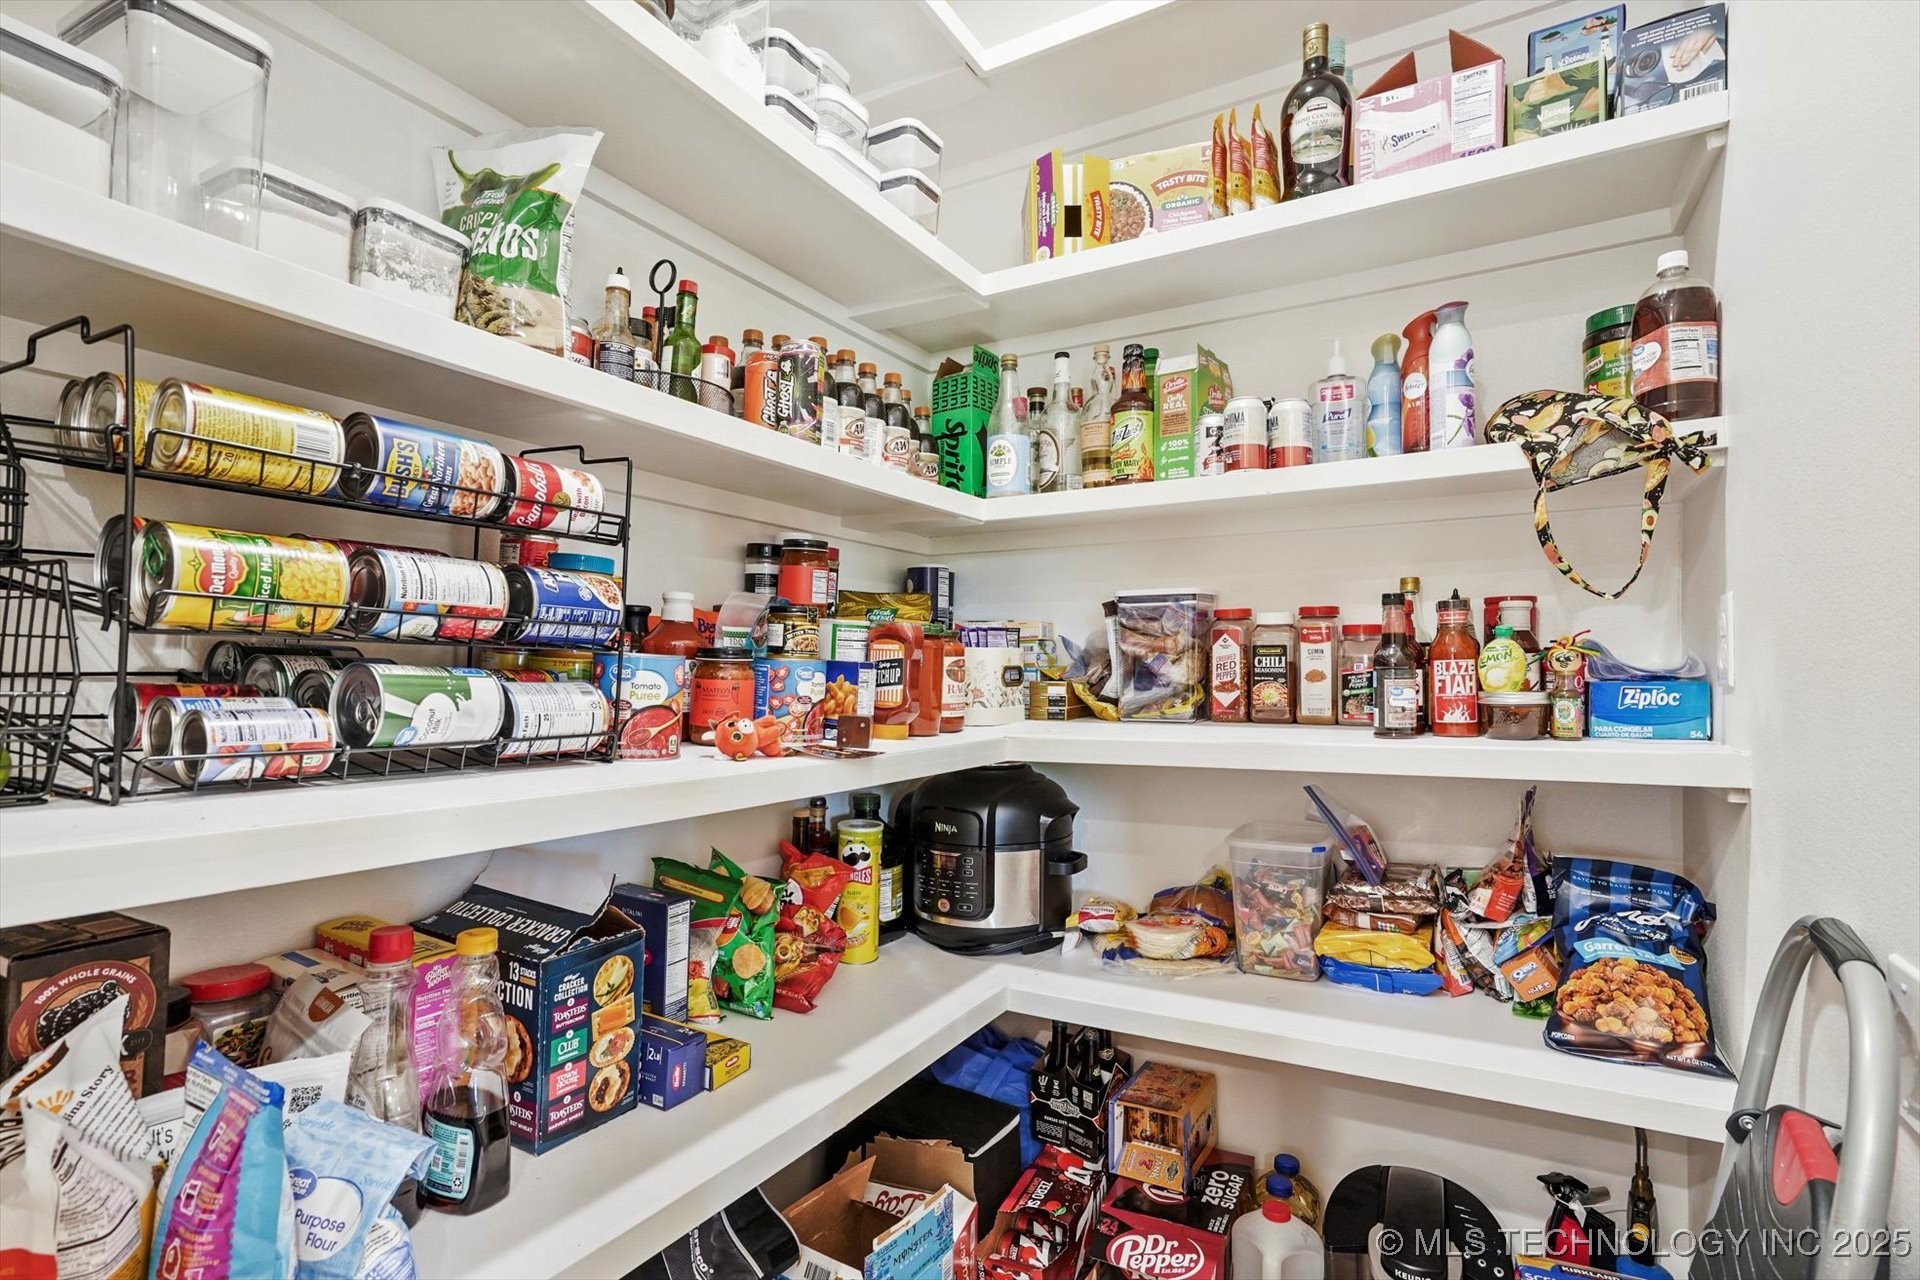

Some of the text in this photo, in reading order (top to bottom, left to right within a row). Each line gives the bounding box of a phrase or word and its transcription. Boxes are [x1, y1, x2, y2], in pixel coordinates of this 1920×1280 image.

[1156, 174, 1208, 191] TASTY BITE
[1165, 198, 1200, 209] ORGANIC
[459, 210, 503, 231] CRISPY
[1093, 194, 1103, 238] TASTY BITE
[973, 350, 999, 374] Sprite
[776, 375, 794, 418] GHOST
[941, 380, 949, 413] mini
[950, 378, 959, 411] mini
[960, 375, 970, 409] mini
[1163, 402, 1187, 410] REAL
[1325, 409, 1350, 421] Purell
[1168, 439, 1189, 447] 100%
[934, 418, 968, 491] Sprite
[387, 440, 416, 498] BUSH'S
[422, 441, 446, 509] Great Northern
[227, 552, 240, 580] Quality
[208, 579, 225, 594] Del
[399, 568, 408, 600] Nutrition
[1215, 653, 1237, 664] CRUSHED
[1215, 660, 1237, 672] RED
[1254, 656, 1286, 668] CHILI
[1434, 661, 1475, 675] BLAZE
[876, 667, 901, 686] TCHUP
[1215, 671, 1237, 681] PEPPER
[1434, 675, 1475, 694] FIAH
[630, 682, 662, 690] Tomato
[629, 691, 662, 701] Puree
[1622, 688, 1681, 709] Ziploc
[418, 707, 436, 741] Coconut
[430, 717, 443, 734] Milk
[1613, 725, 1654, 733] CONGELAR
[1689, 730, 1704, 738] 54
[934, 821, 958, 835] NINJA
[849, 870, 872, 883] NGLES
[1571, 874, 1596, 884] BATCH
[1609, 882, 1634, 890] BATCH
[1647, 887, 1671, 896] FROM
[445, 900, 571, 944] CRACKER COLLECTIO
[621, 908, 643, 918] DITALINI
[1583, 941, 1631, 952] Garre
[508, 960, 537, 981] 13 STACKS
[33, 967, 138, 1006] 100% WHOLE GRAINS
[553, 984, 588, 1003] COLLECTION
[558, 978, 585, 993] CRACKER
[497, 983, 534, 1011] CTION
[553, 1004, 588, 1023] TOASTEDS
[1549, 1030, 1576, 1041] POPCORN
[557, 1037, 580, 1056] CLUB
[83, 1064, 116, 1100] Story
[556, 1070, 579, 1082] TOWN
[556, 1076, 580, 1091] HOUSE
[548, 1110, 584, 1131] HARVEST WHEAT
[549, 1100, 584, 1122] TOASTEDS
[1148, 1154, 1164, 1180] TANK
[1031, 1180, 1054, 1200] ZERO
[1200, 1170, 1231, 1207] zero
[1220, 1174, 1245, 1210] SUGAR
[294, 1207, 346, 1234] Purpose
[1101, 1218, 1119, 1232] 24
[304, 1231, 338, 1252] Flour
[1144, 1234, 1179, 1255] Dr
[960, 1242, 970, 1280] ugar
